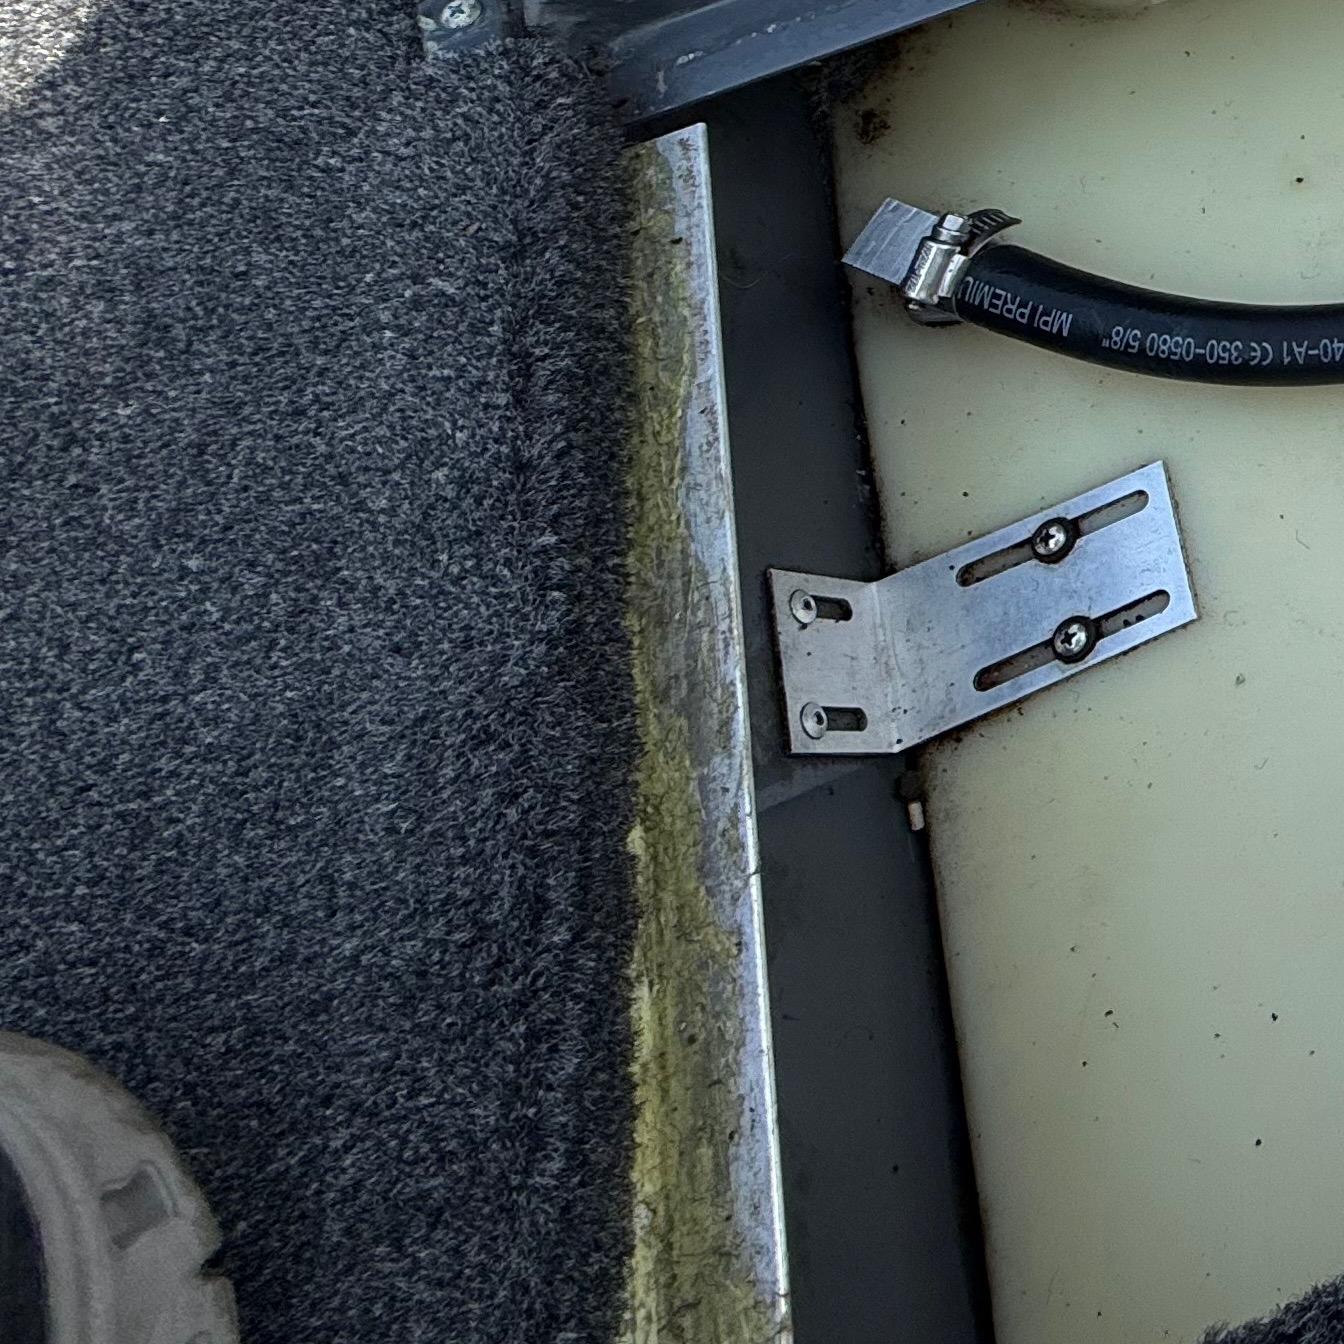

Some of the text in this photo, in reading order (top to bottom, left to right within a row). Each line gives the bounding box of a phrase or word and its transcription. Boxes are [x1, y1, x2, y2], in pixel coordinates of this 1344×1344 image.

[956, 274, 1032, 324] PREMIU
[1033, 304, 1073, 336] MPI
[1101, 325, 1140, 351] 5/8"
[1146, 333, 1241, 363] 350-0580
